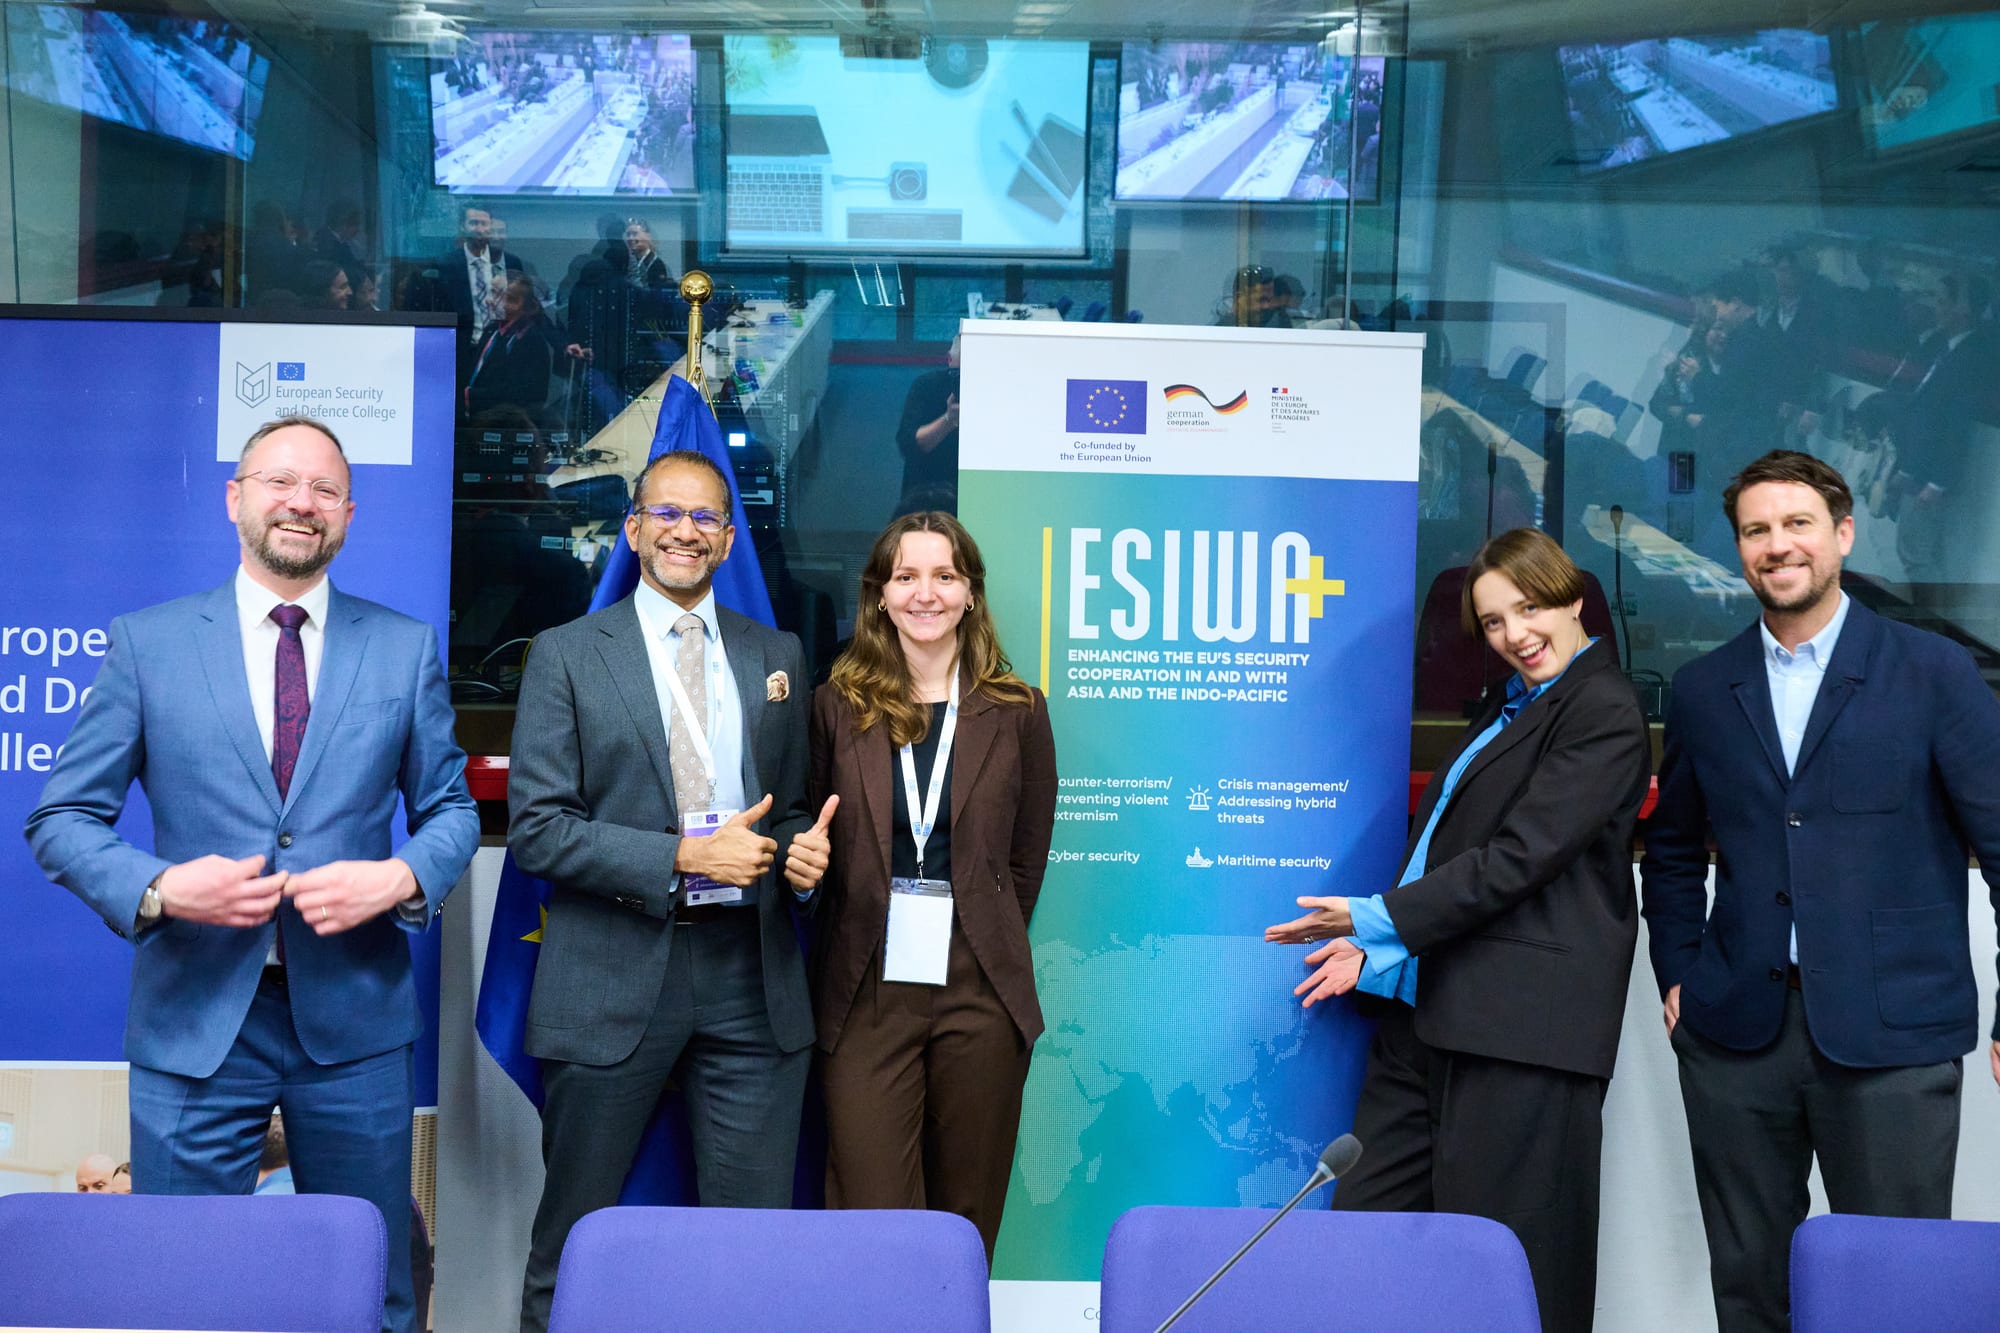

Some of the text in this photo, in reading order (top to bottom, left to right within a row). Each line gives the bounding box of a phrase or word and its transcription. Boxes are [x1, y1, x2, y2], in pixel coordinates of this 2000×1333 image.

[276, 386, 383, 402] European Security
[301, 405, 349, 418] Defence
[352, 405, 396, 421] College
[1166, 410, 1204, 419] german
[1166, 419, 1210, 427] cooperation
[1074, 441, 1136, 452] Co-funded by
[1060, 453, 1152, 463] the European Union
[1, 627, 108, 667] rope
[1067, 649, 1310, 666] ENHANCING THE EU'S SECURITY
[1067, 667, 1287, 684] COOPERATION IN AND WITH
[1067, 685, 1288, 702] ASIA AND THE INDO-PACIFIC
[1058, 776, 1173, 790] ounter-terrorism/
[1218, 778, 1349, 793] Crisis management/
[1056, 793, 1169, 807] reventing violent
[1217, 795, 1337, 810] Addressing hybrid
[1054, 810, 1118, 821] xtremism
[1217, 812, 1265, 824] threats
[1047, 850, 1140, 864] Cyber security
[1217, 854, 1332, 870] Maritime security
